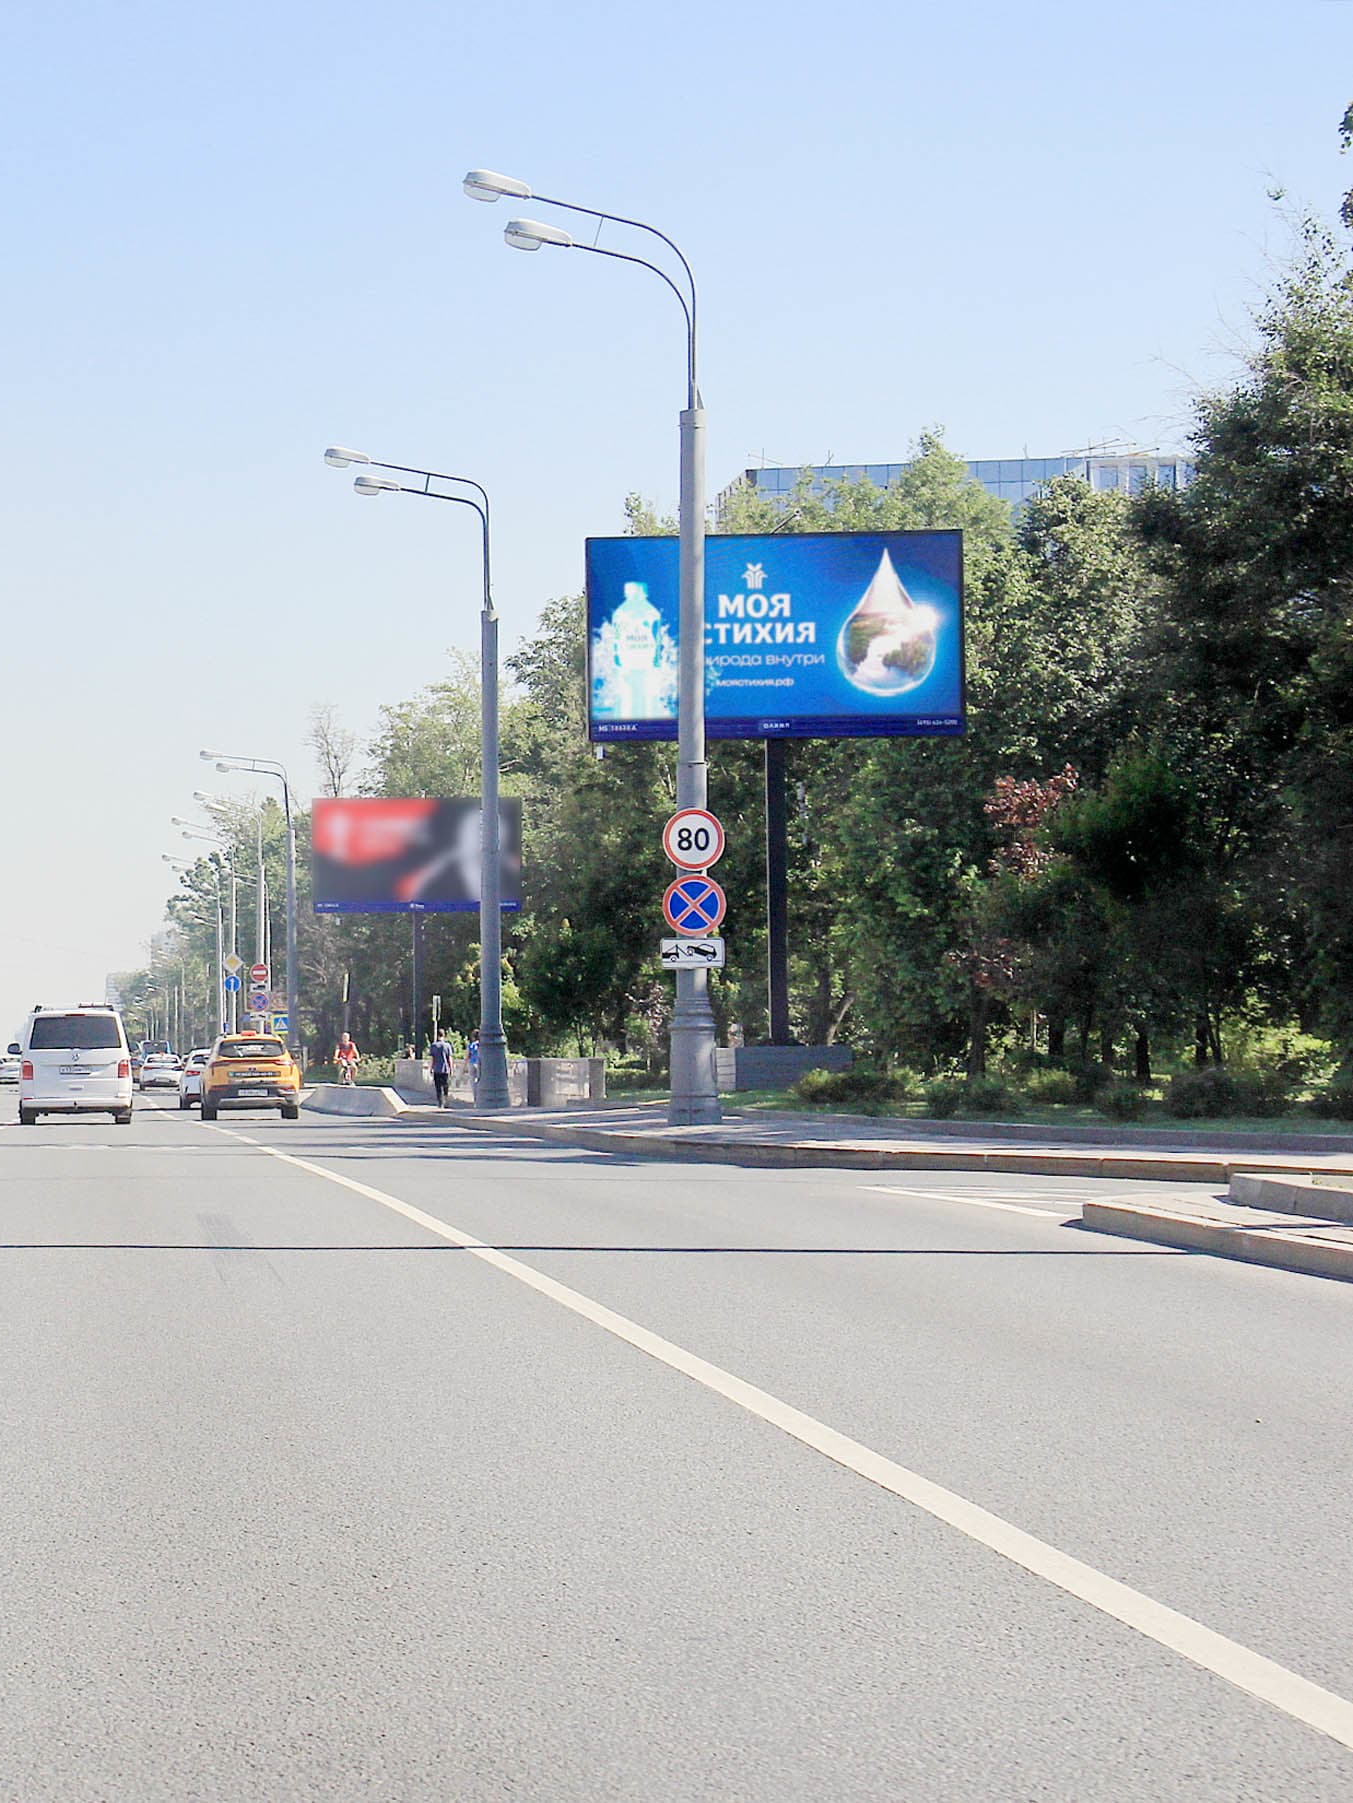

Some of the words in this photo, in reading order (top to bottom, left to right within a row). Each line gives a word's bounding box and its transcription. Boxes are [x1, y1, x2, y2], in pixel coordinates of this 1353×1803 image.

[718, 594, 791, 618] МОЯ
[705, 655, 762, 667] ирода
[765, 653, 825, 667] внутри
[678, 827, 710, 851] 80
